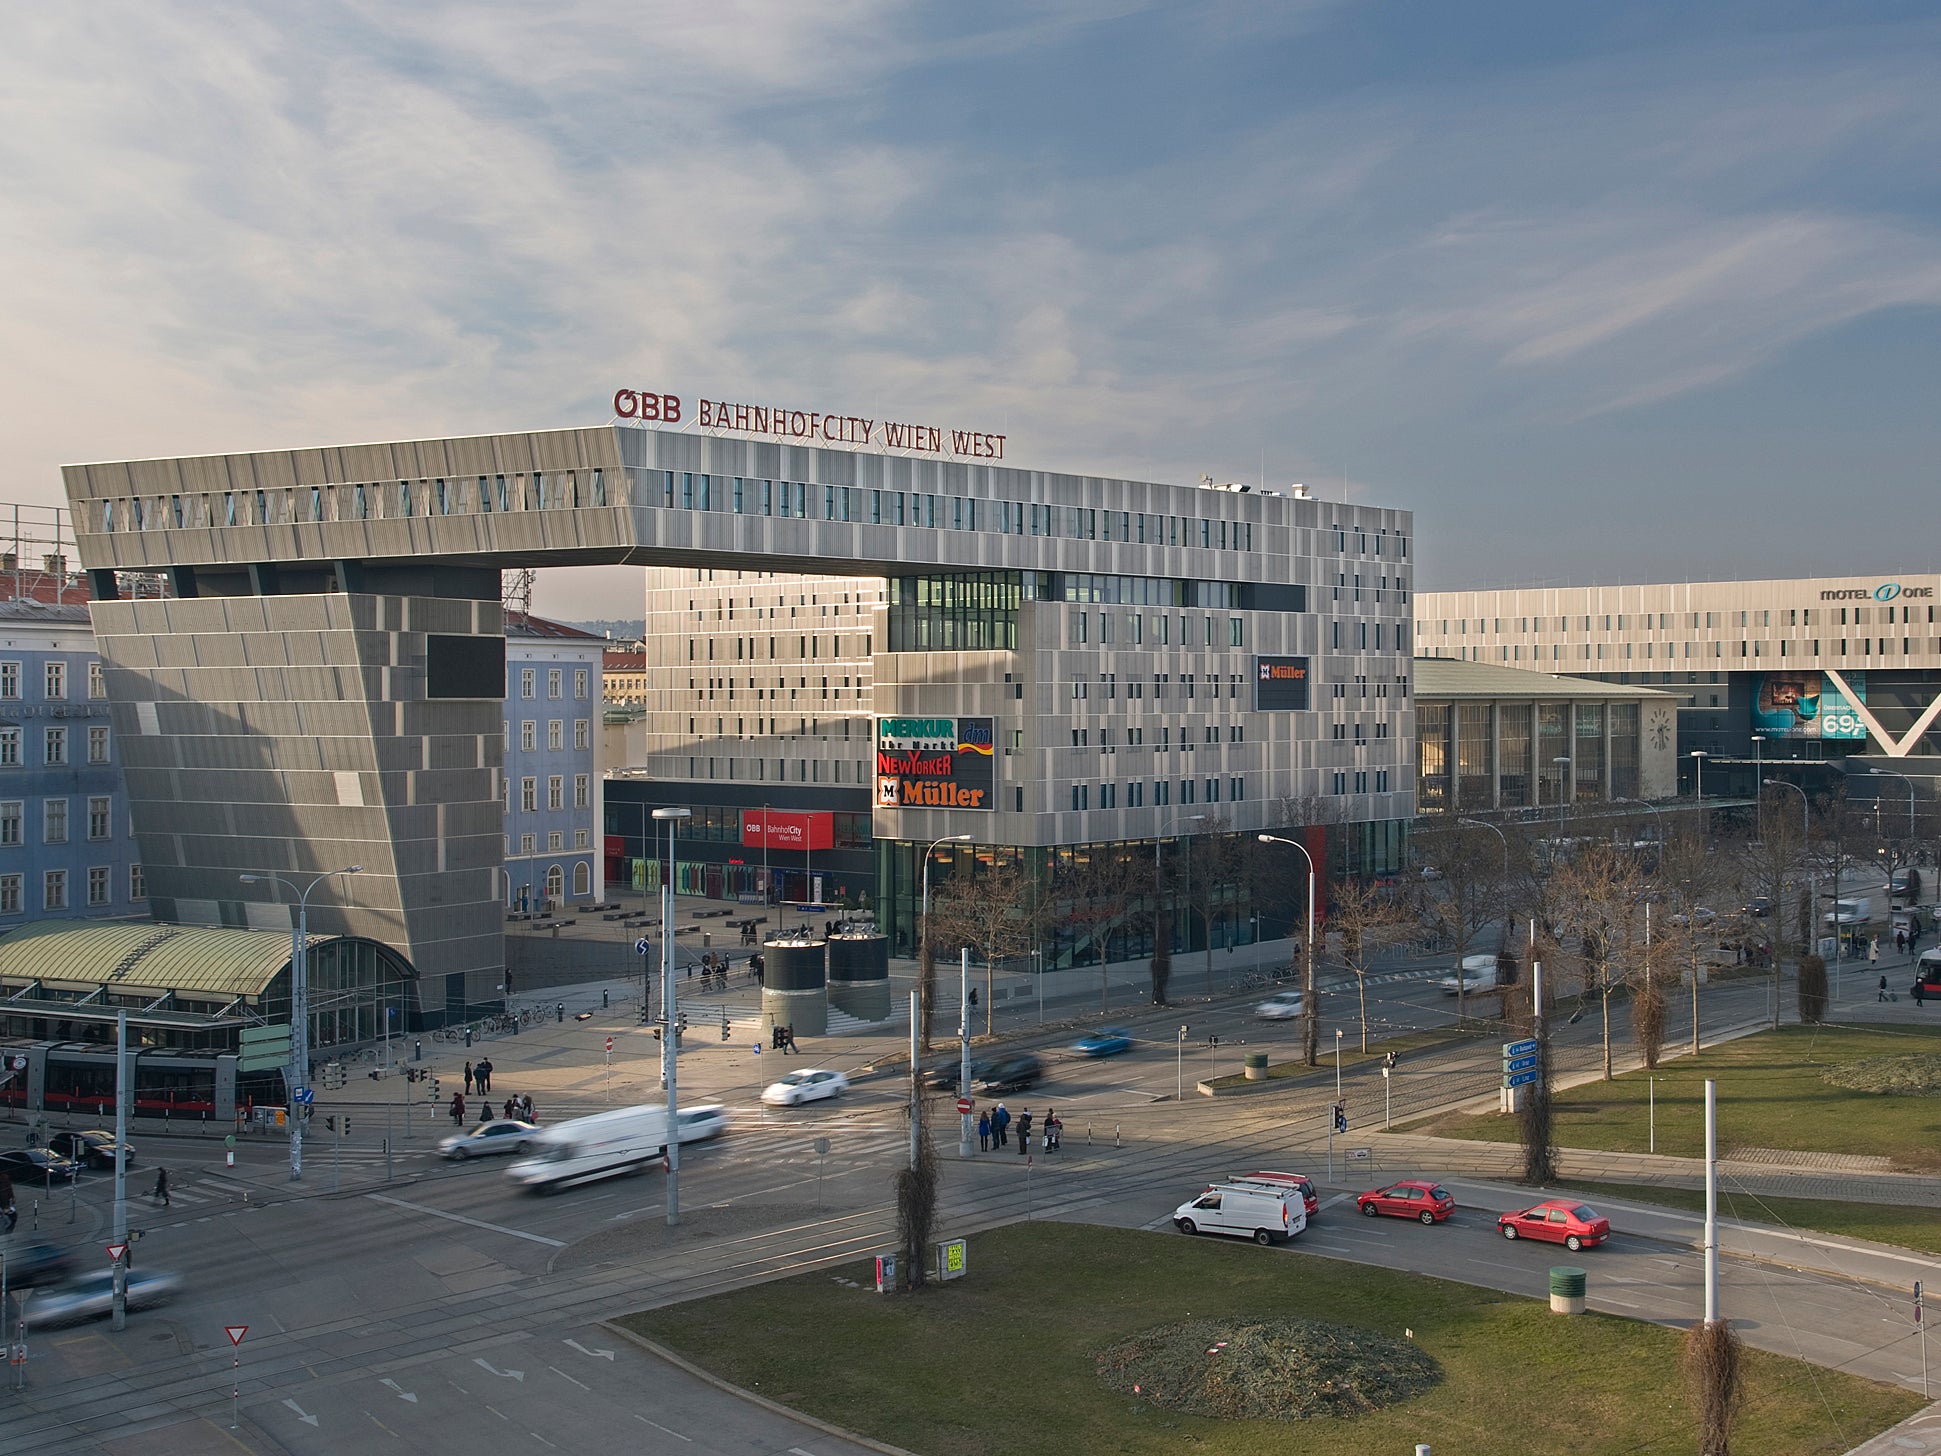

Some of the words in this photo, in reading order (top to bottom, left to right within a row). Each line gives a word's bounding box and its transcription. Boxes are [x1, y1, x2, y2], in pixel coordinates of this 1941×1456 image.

[614, 389, 681, 423] ÖBB
[699, 399, 873, 444] BAHNHOFCITY
[885, 421, 940, 452] WIEN
[952, 429, 1006, 459] WEST
[1271, 665, 1306, 679] Müller
[881, 719, 954, 738] MERKUR
[963, 722, 990, 744] dm
[881, 740, 903, 750] Ihr
[912, 740, 955, 750] Markt
[902, 781, 984, 806] Müller
[767, 825, 801, 836] BahnhofCity
